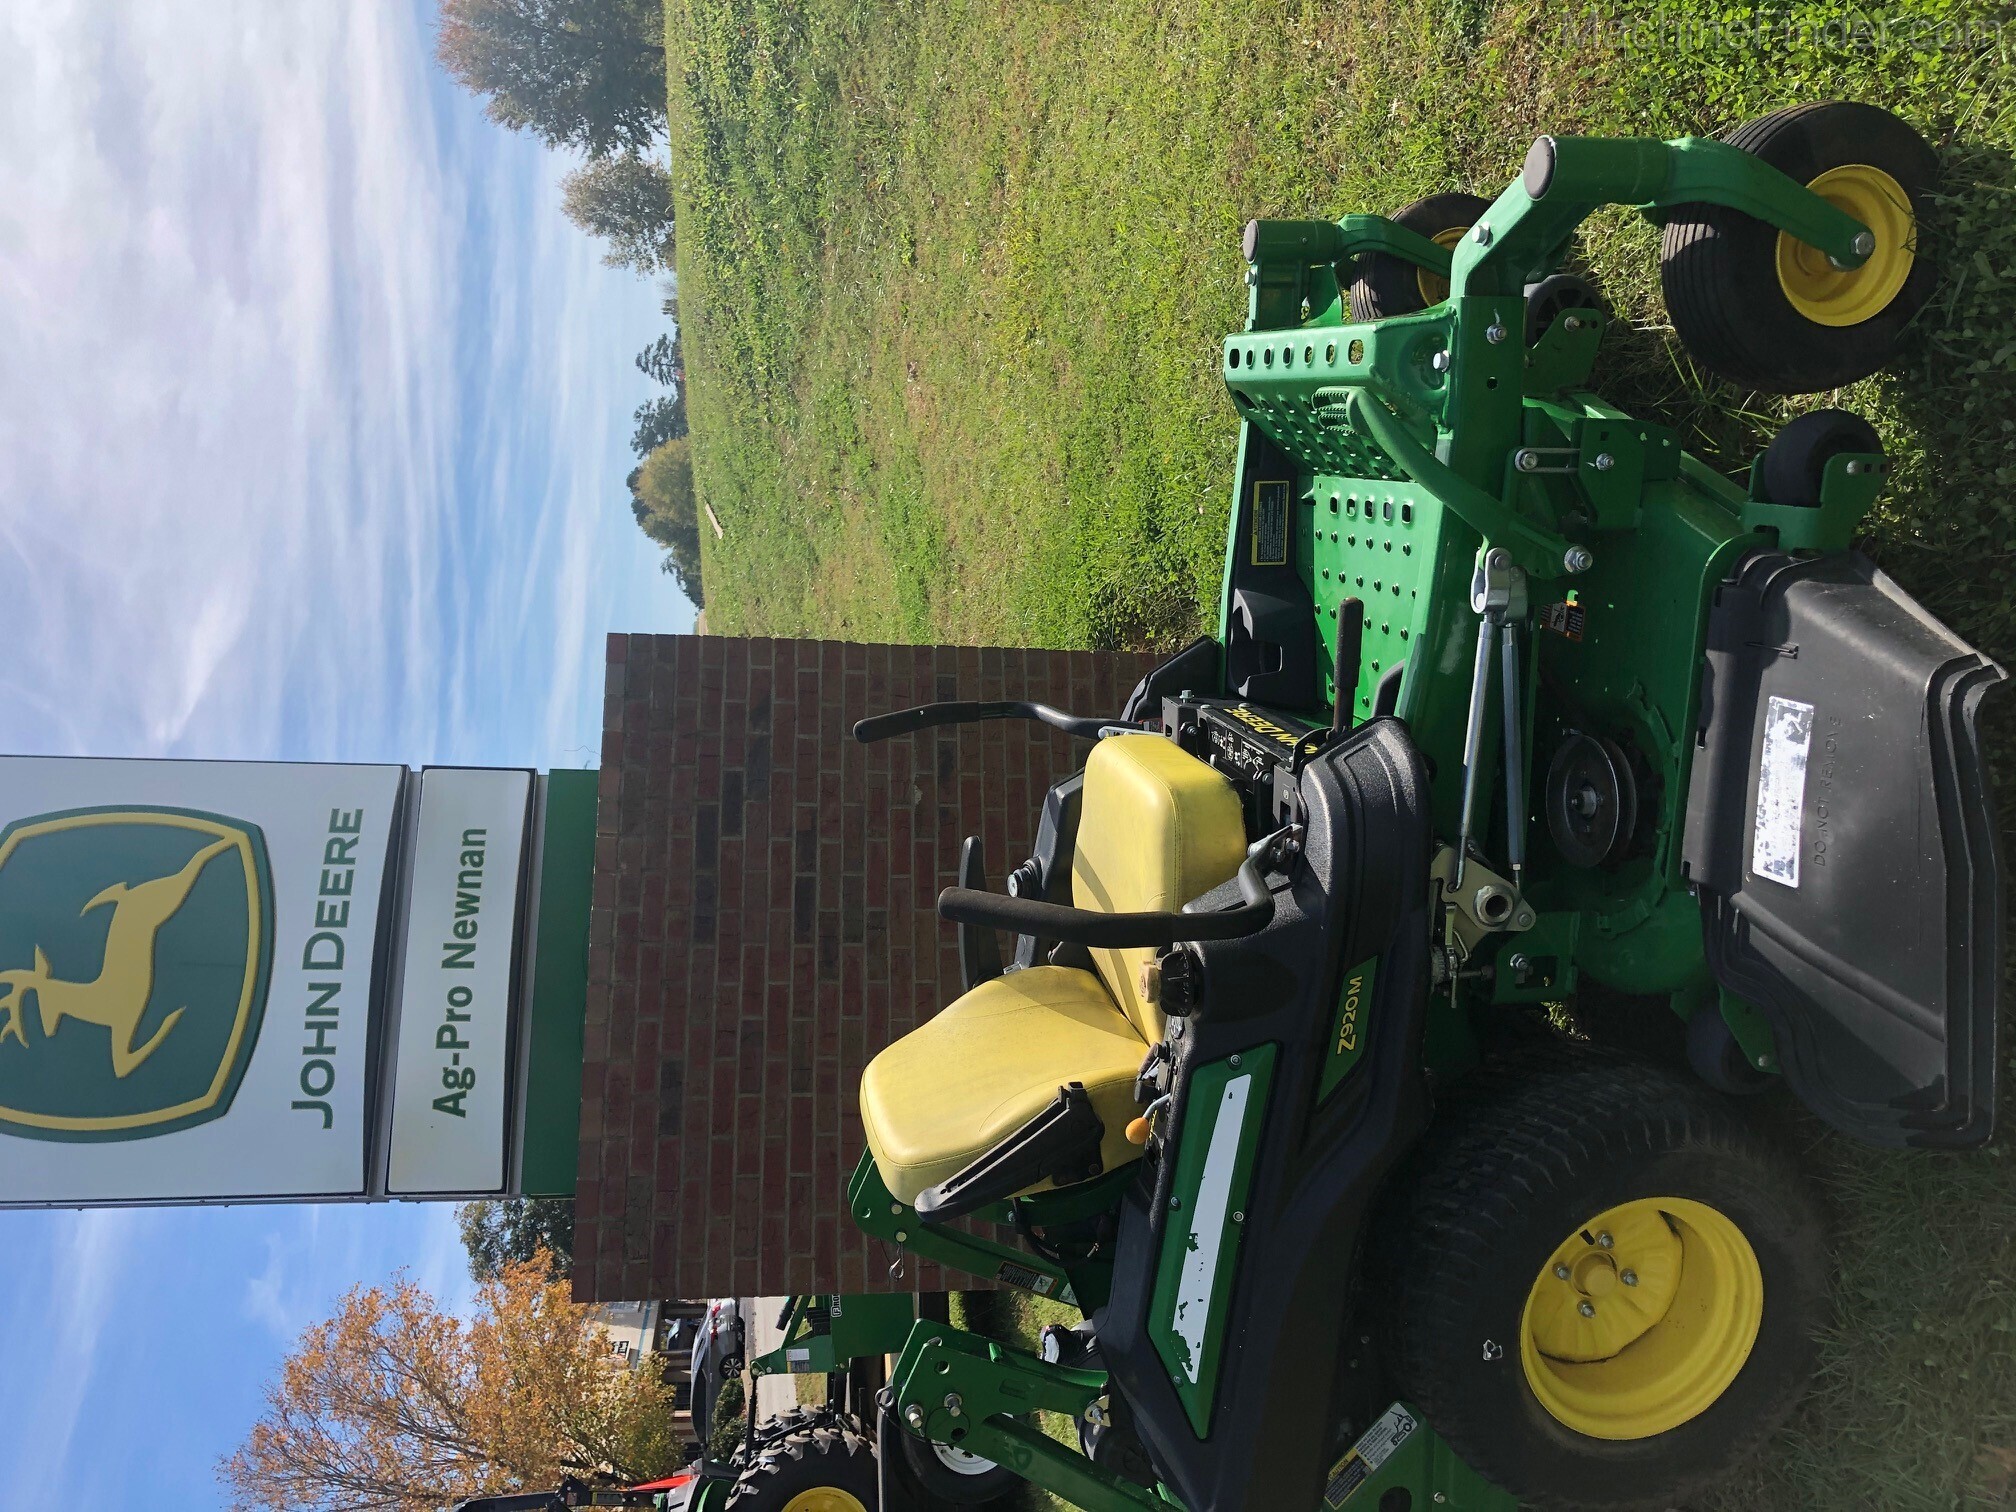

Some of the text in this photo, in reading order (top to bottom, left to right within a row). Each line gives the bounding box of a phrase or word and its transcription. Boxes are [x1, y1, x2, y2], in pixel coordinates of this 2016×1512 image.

[1222, 708, 1285, 732] DEERE
[1814, 715, 1842, 867] DO NOT REMOVE
[290, 808, 364, 1130] JOHN DEERE
[432, 827, 488, 1119] Ag-Pro Newnan
